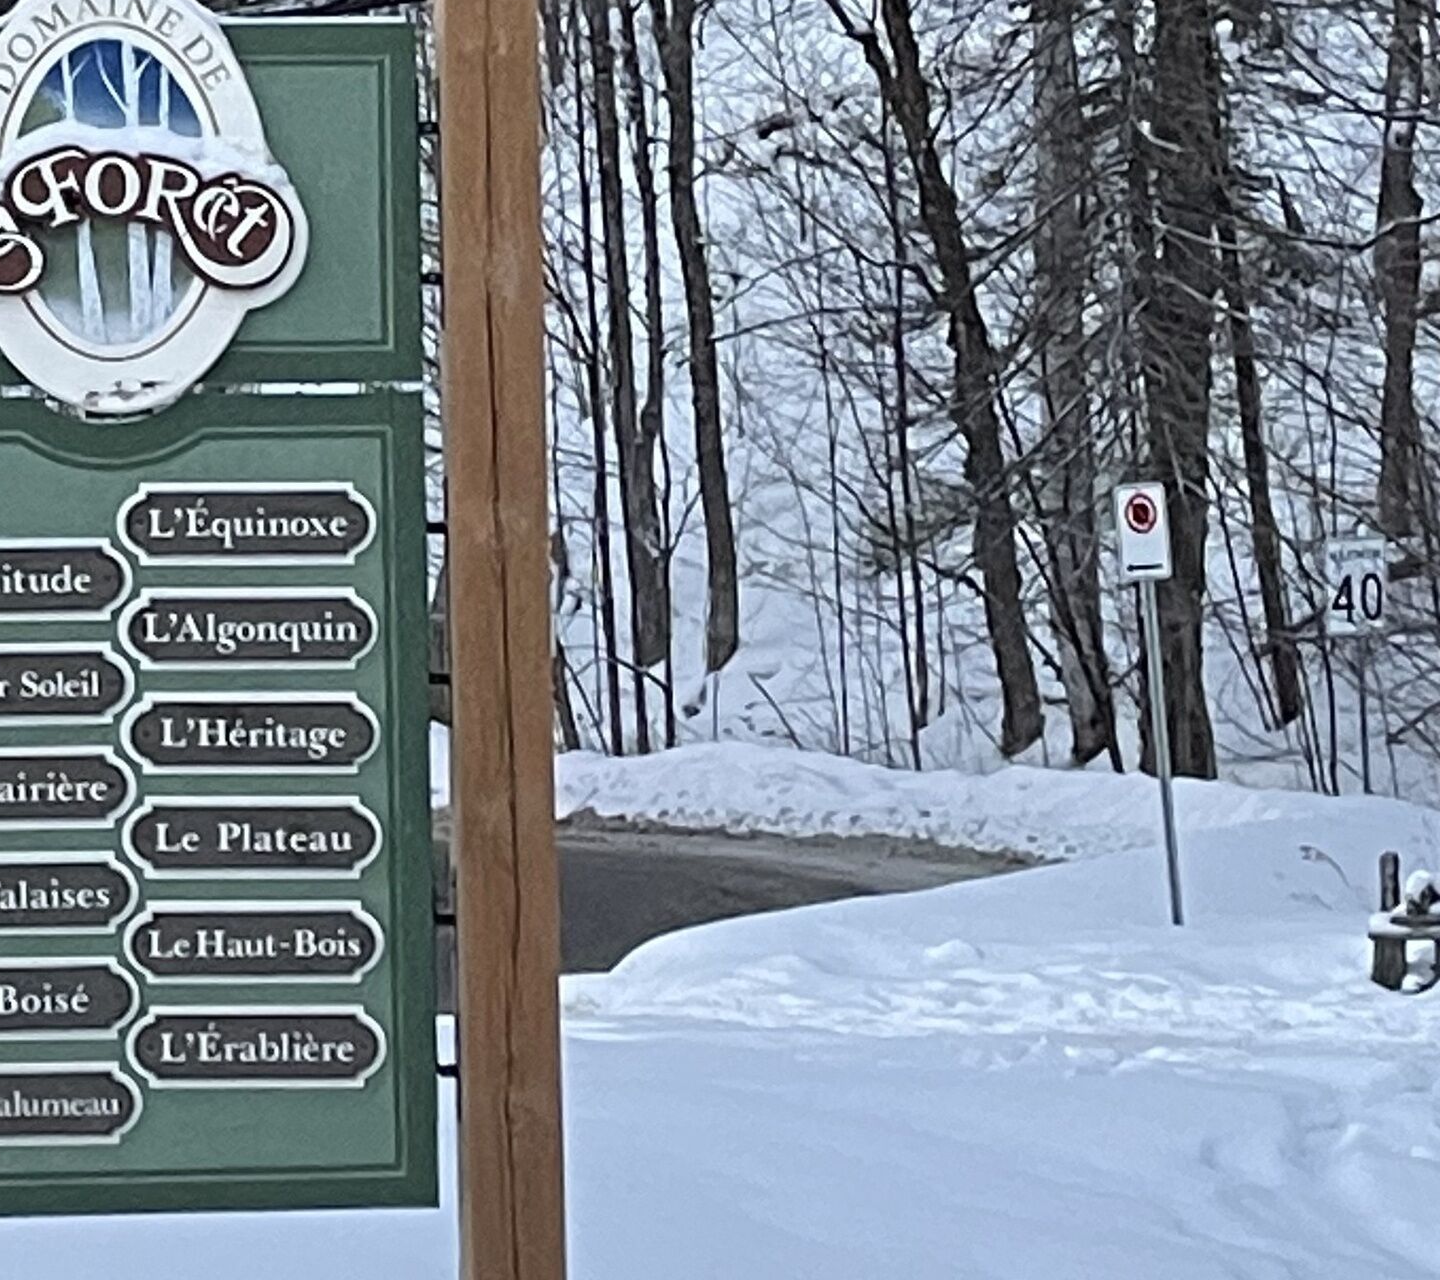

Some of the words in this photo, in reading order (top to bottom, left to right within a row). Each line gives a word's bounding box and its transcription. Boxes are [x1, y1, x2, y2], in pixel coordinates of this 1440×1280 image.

[183, 33, 231, 92] DE
[148, 497, 349, 549] L'Équinoxe
[1331, 572, 1383, 625] 40
[142, 611, 359, 654] L'Algonquin
[19, 669, 100, 698] Soleil
[160, 717, 348, 759] L'Héritage
[155, 823, 201, 853] Le
[217, 822, 354, 852] Plateau
[148, 930, 191, 959] Le
[195, 928, 362, 958] Haut-Bois
[160, 1022, 355, 1064] L'Érablière
